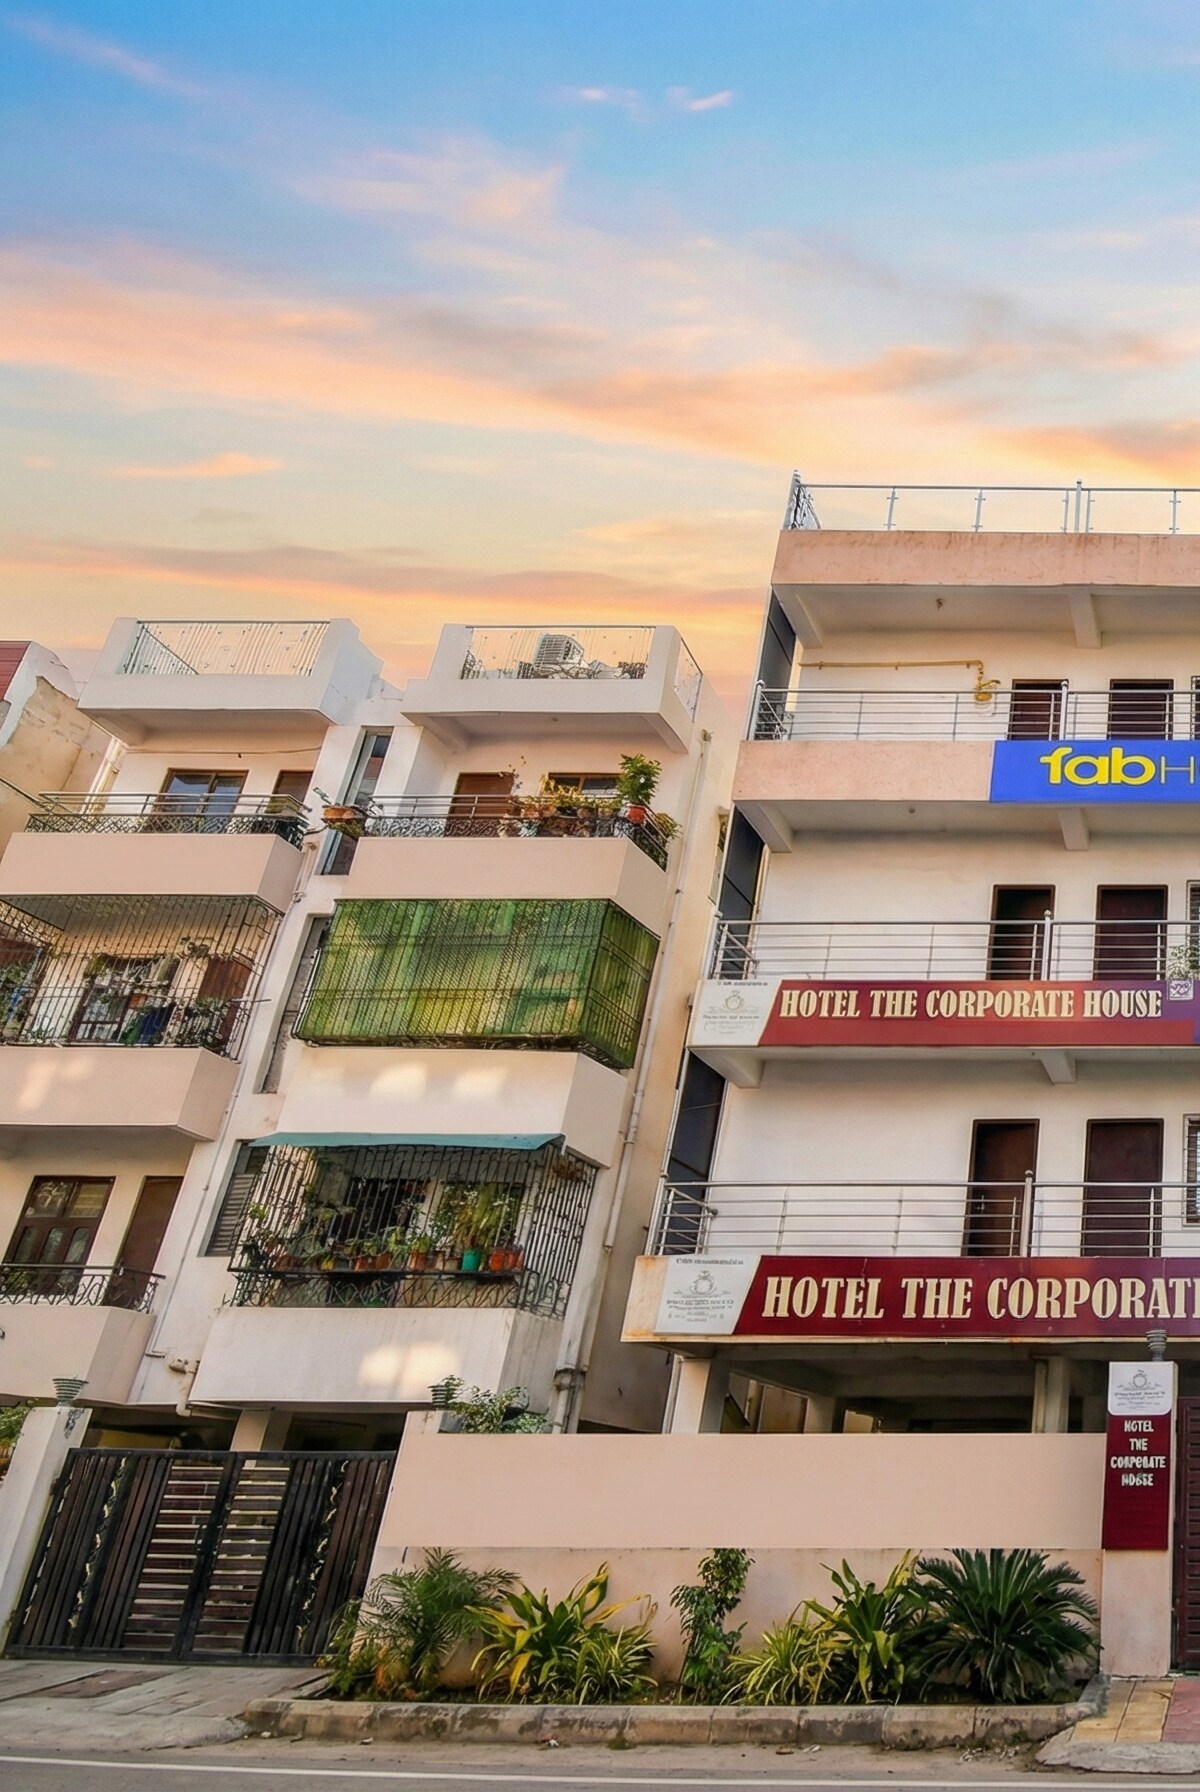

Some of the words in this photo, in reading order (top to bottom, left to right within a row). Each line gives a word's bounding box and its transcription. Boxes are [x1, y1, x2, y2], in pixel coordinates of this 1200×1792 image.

[779, 989, 861, 1018] HOTEL
[870, 989, 918, 1018] THE
[925, 989, 1075, 1018] CORPORATE
[1082, 989, 1162, 1018] HOUSE
[761, 1275, 885, 1320] HOTEL
[901, 1277, 974, 1320] THE
